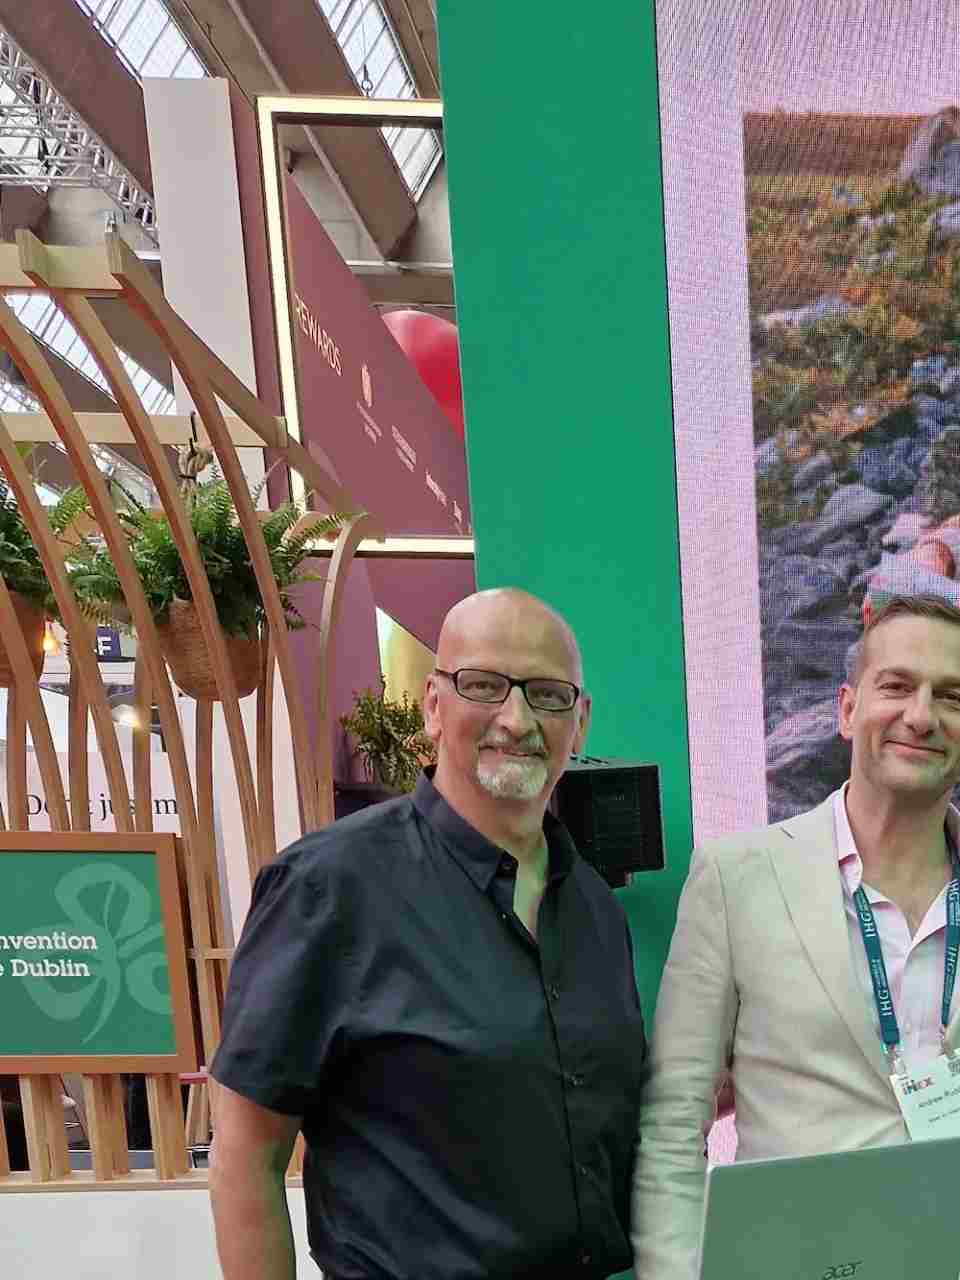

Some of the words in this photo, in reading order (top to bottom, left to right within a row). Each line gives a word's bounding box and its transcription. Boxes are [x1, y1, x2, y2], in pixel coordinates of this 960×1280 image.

[859, 911, 877, 938] IHG
[10, 959, 90, 977] Dublin
[947, 945, 958, 974] IHG
[878, 988, 893, 1017] IHG
[822, 1261, 864, 1280] acer
